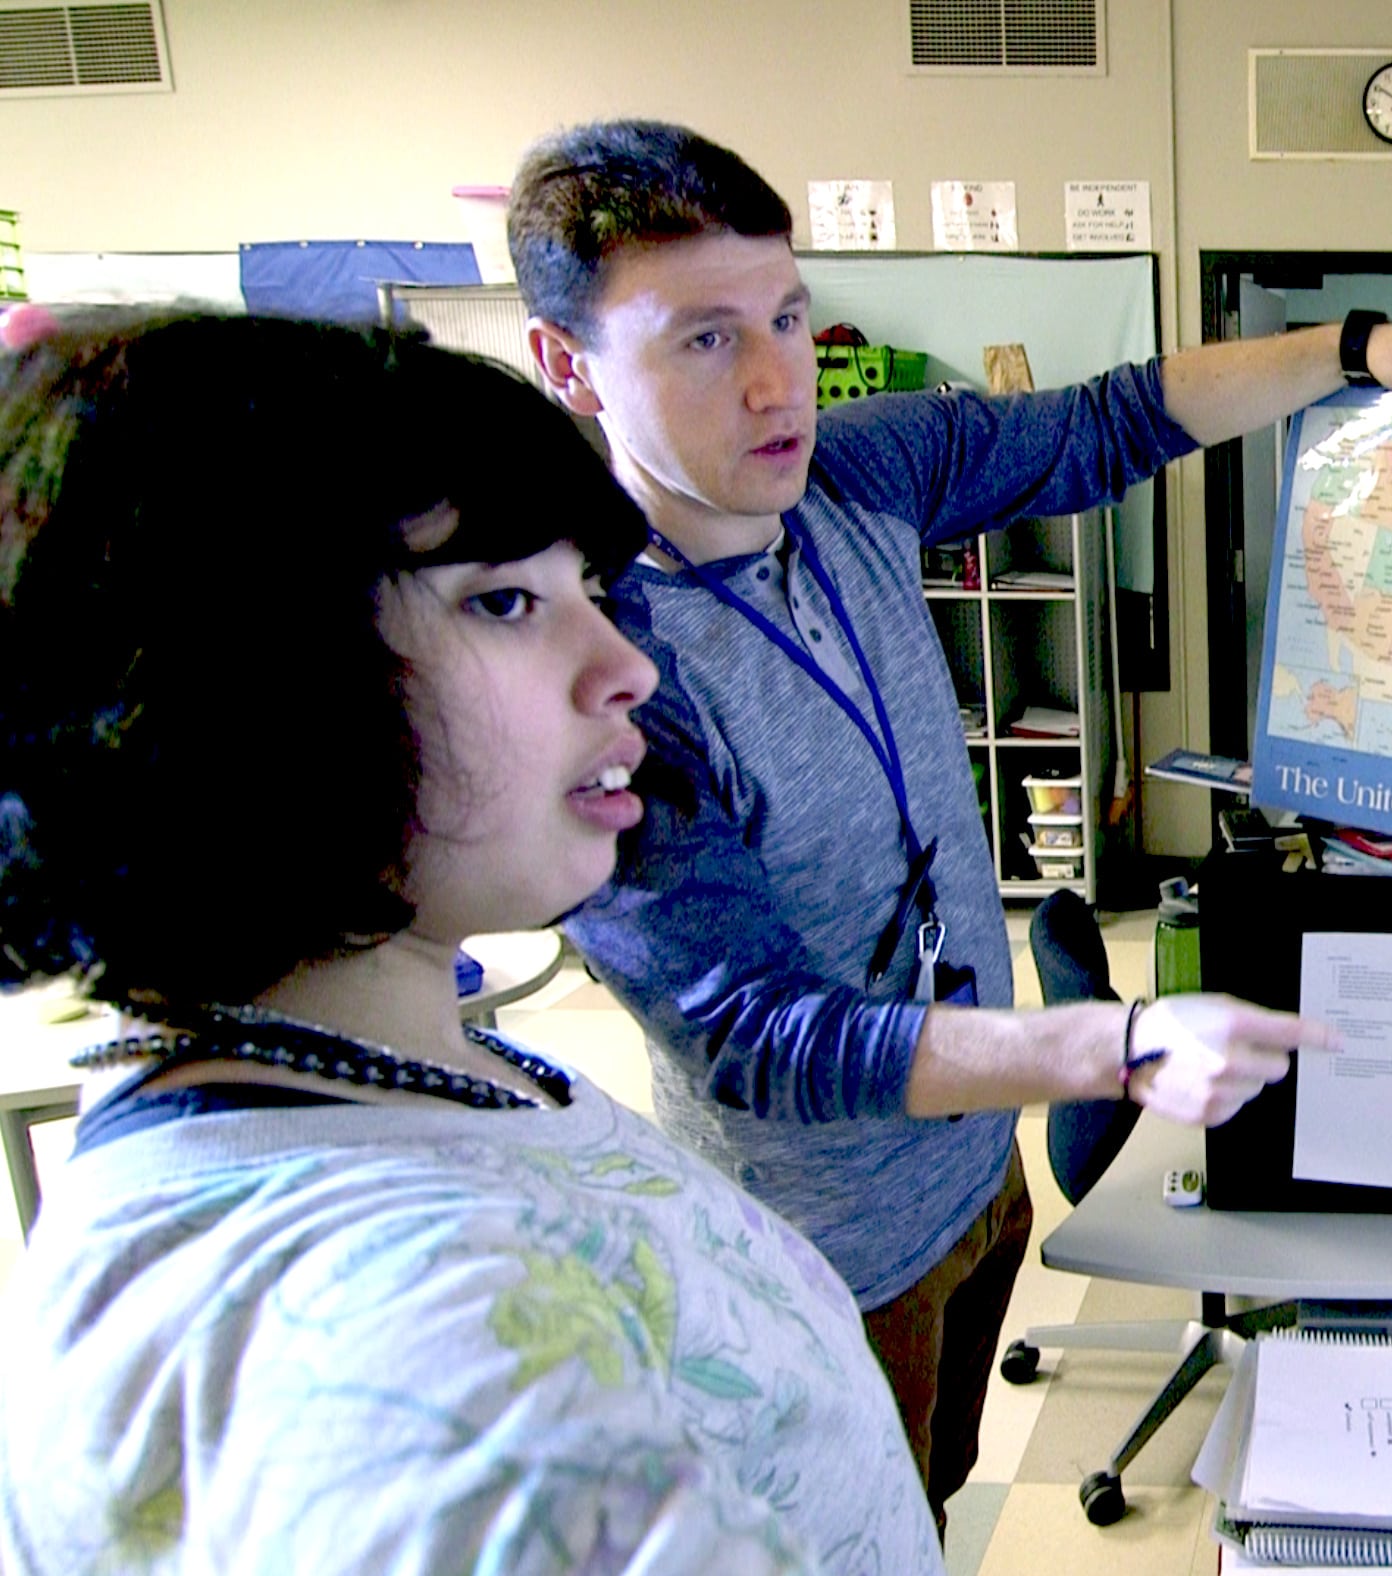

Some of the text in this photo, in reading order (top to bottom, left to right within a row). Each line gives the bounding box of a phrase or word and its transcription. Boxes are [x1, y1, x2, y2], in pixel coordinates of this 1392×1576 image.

[1069, 183, 1138, 193] BE INDEPENDENT
[1275, 764, 1328, 799] The
